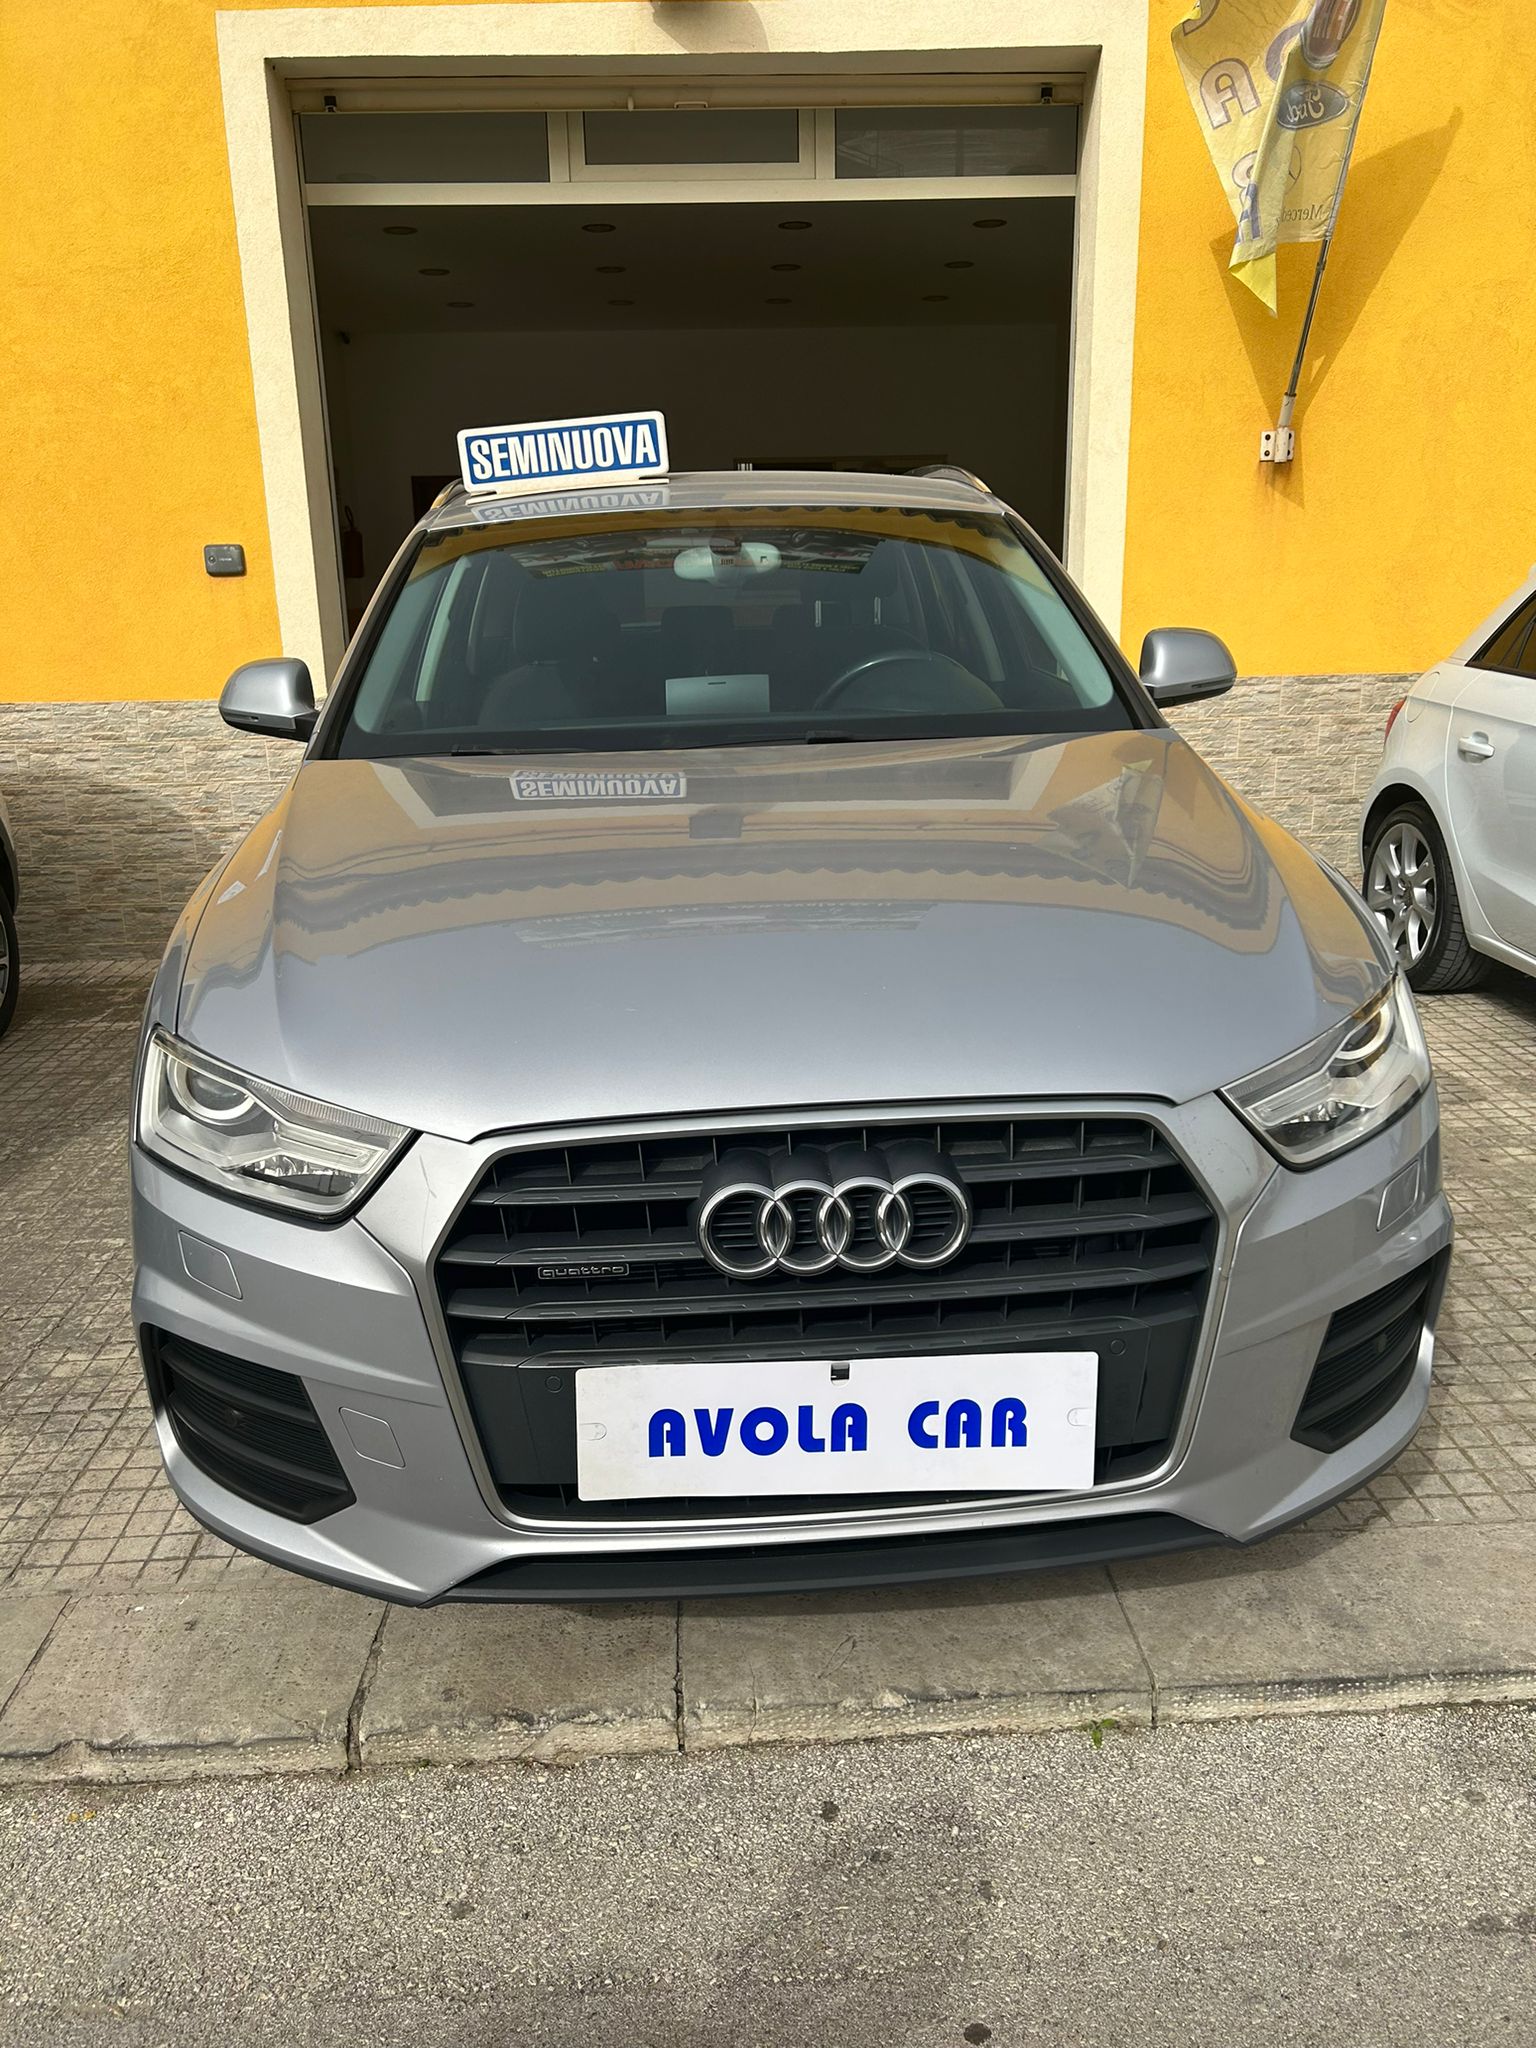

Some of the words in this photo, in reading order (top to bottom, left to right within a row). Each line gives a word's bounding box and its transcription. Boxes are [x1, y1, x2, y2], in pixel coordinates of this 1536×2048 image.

[470, 423, 658, 480] SEMINUOVA
[542, 1265, 625, 1278] quattro
[648, 1402, 868, 1458] AVOLA
[907, 1397, 1028, 1449] CAR
